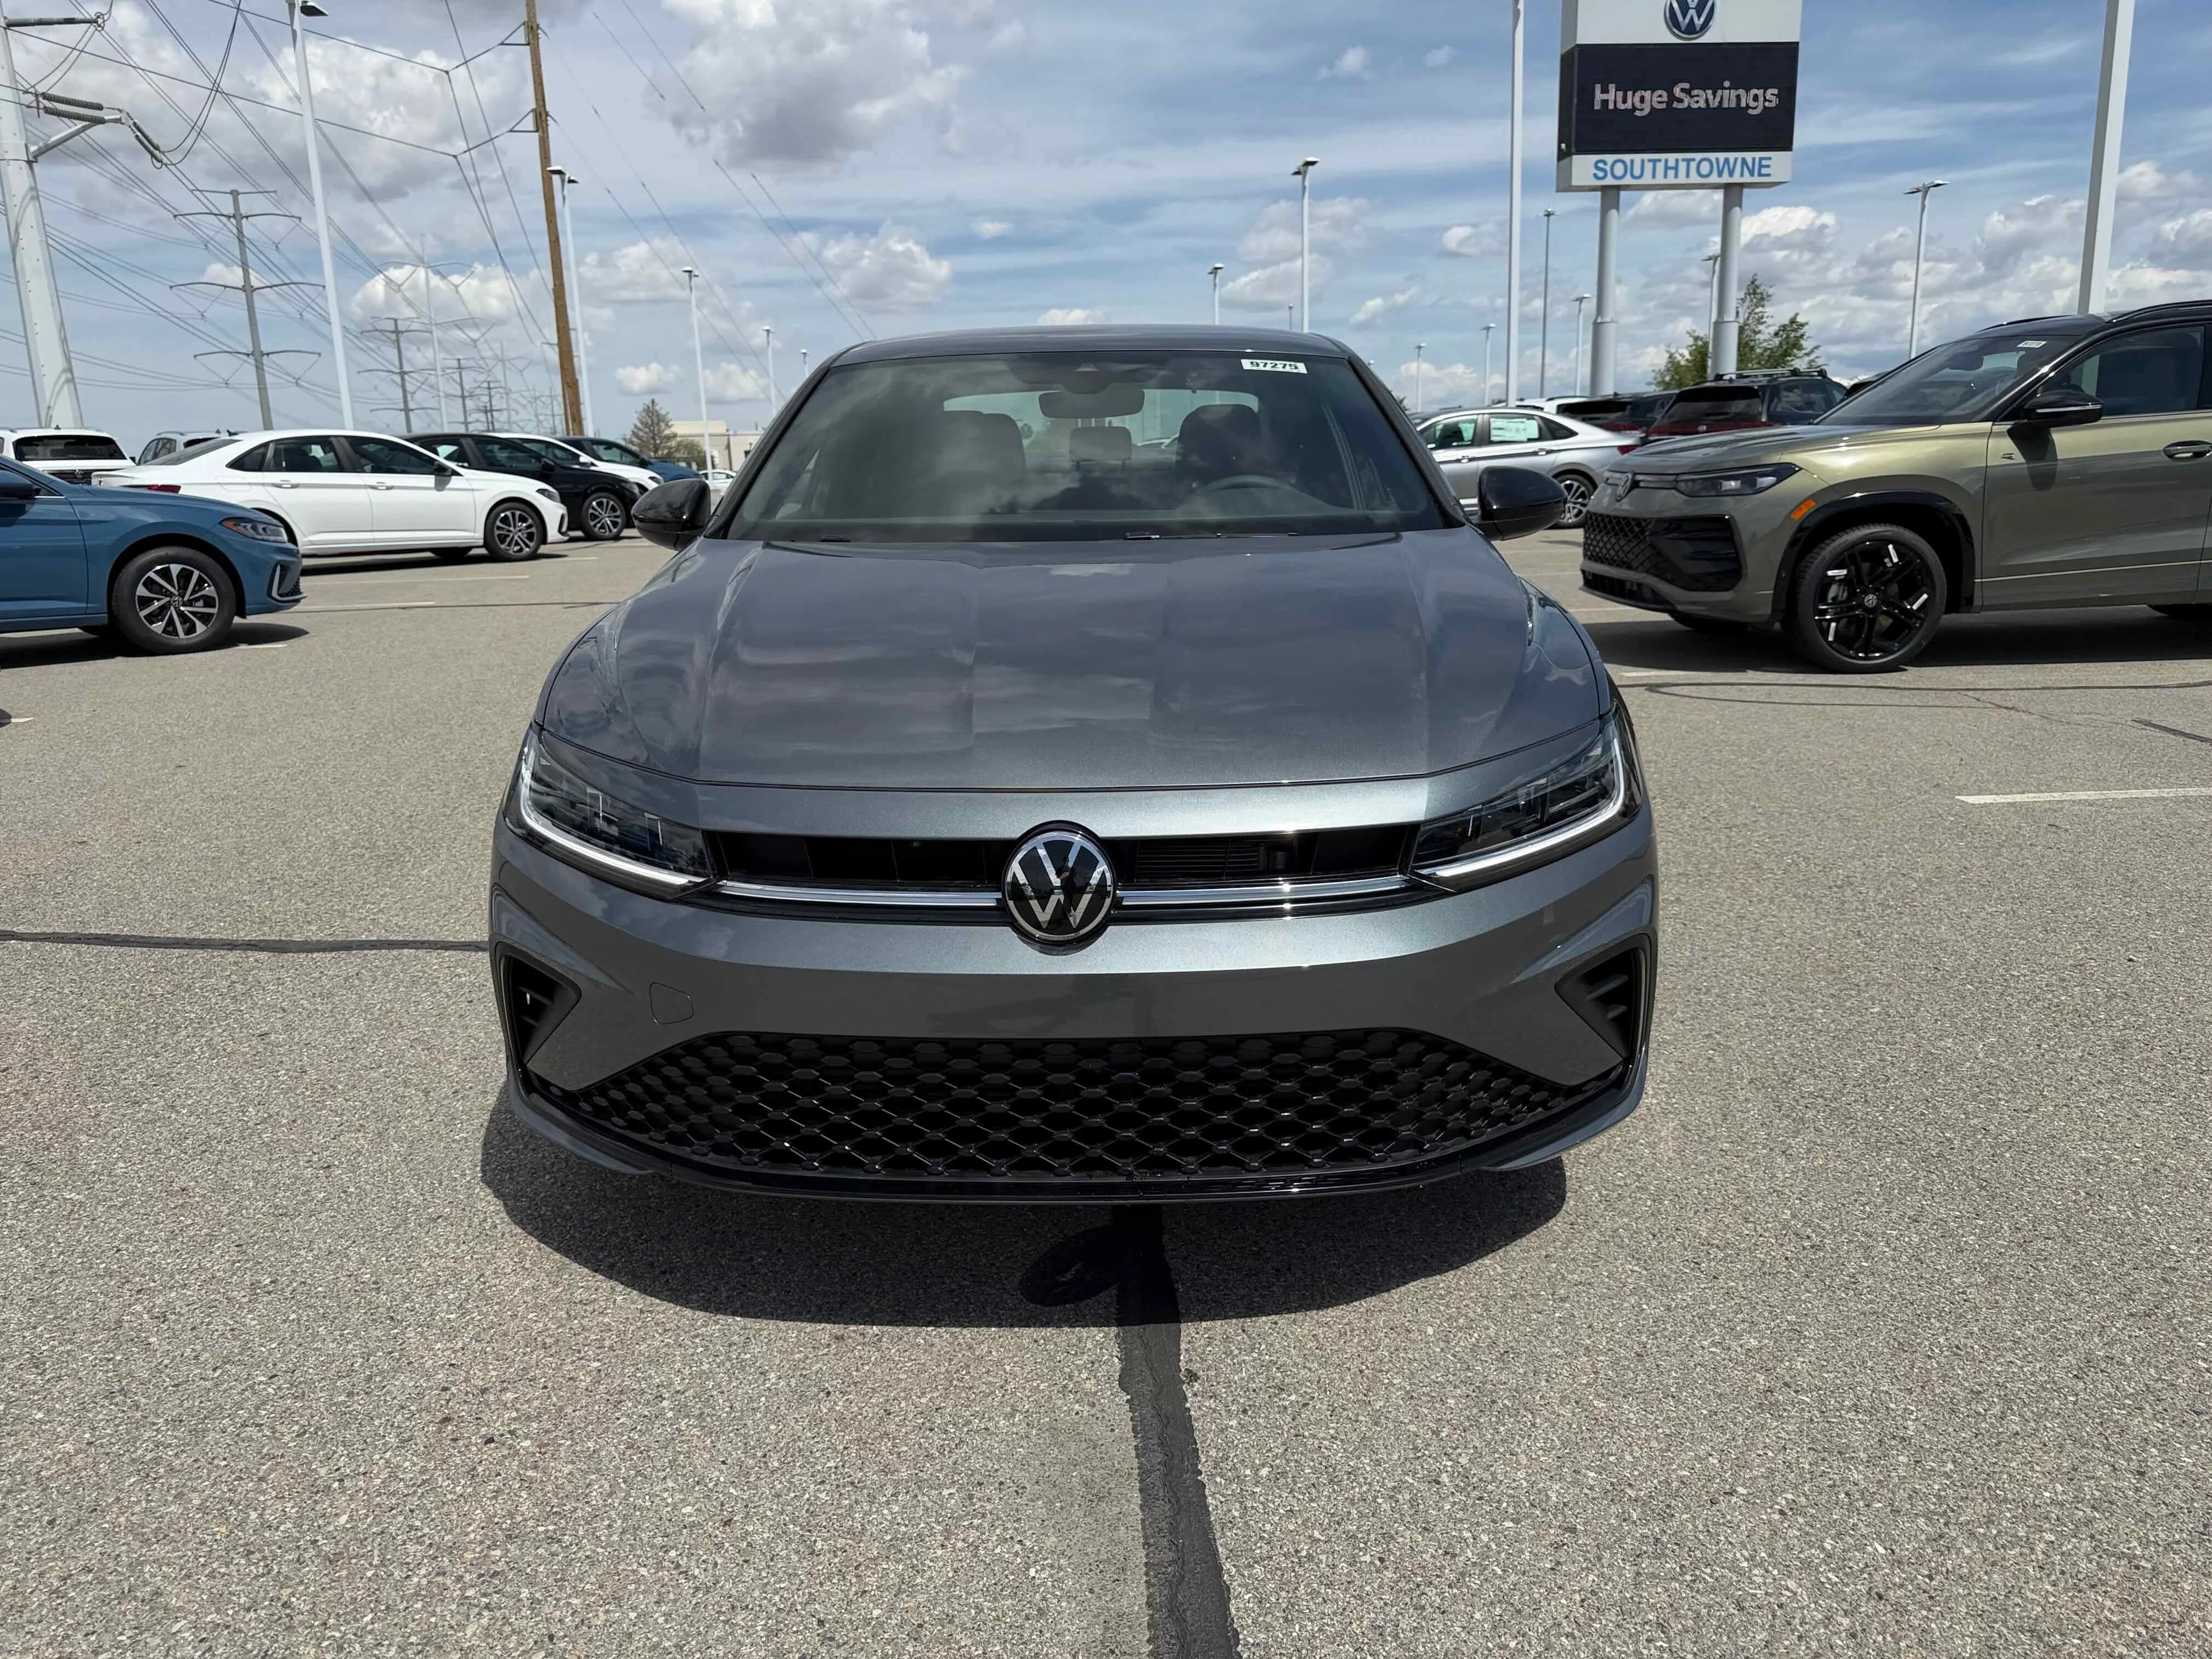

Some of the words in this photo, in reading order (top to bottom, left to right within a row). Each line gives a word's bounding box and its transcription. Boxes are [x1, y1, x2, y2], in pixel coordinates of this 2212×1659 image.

[1594, 83, 1668, 116] Huge
[1672, 81, 1779, 115] Savings
[1593, 156, 1772, 180] SOUTHTOWNE
[1250, 361, 1299, 370] 97275
